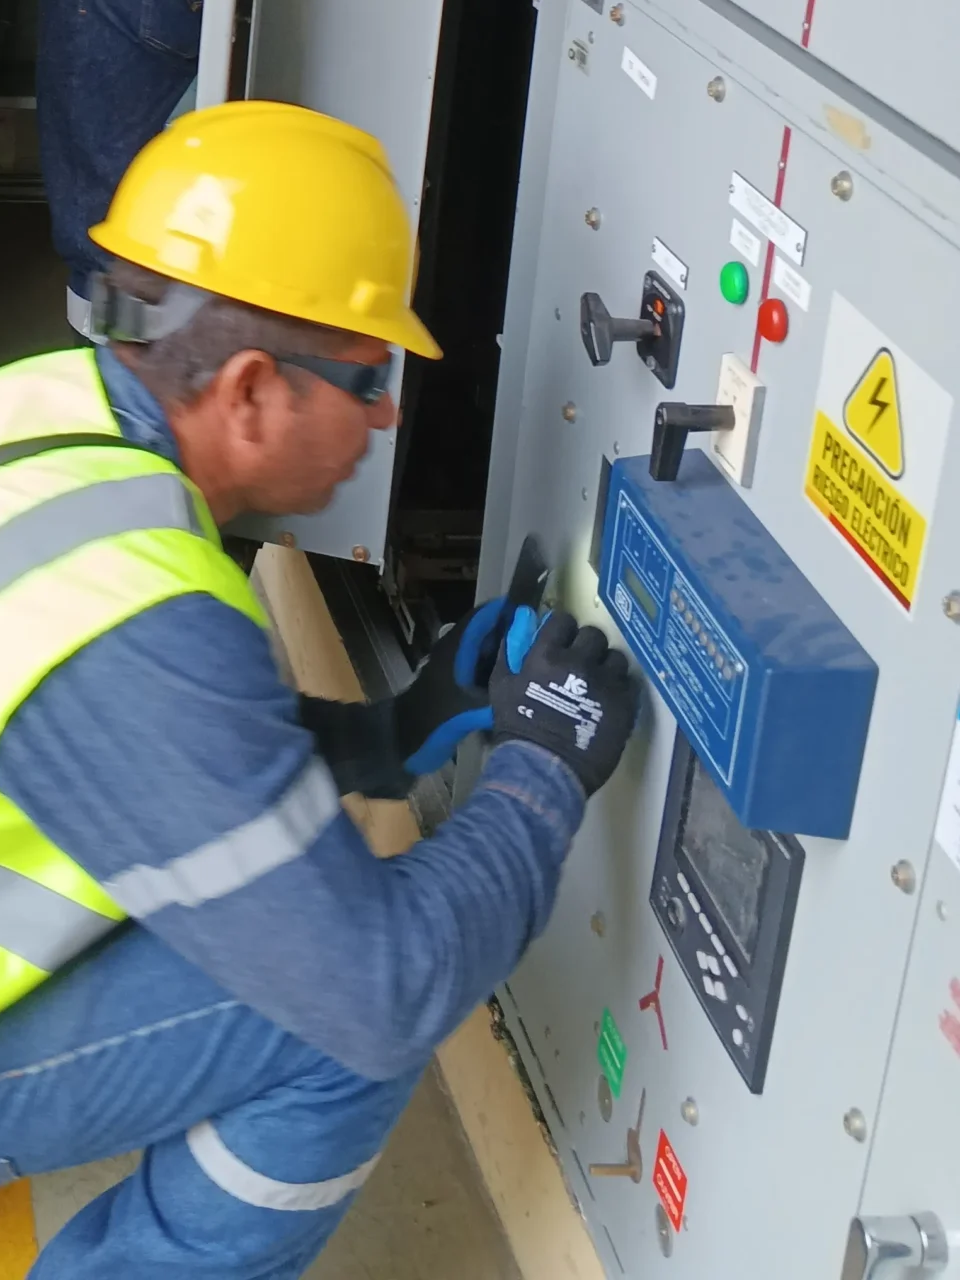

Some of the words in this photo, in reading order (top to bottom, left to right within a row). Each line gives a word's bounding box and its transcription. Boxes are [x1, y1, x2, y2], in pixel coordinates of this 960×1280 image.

[821, 431, 912, 549] PRECAUCIÓN
[812, 463, 850, 520] RIESGO
[850, 505, 910, 588] ELÉCTRICO
[518, 705, 534, 719] CE
[563, 673, 588, 696] KG
